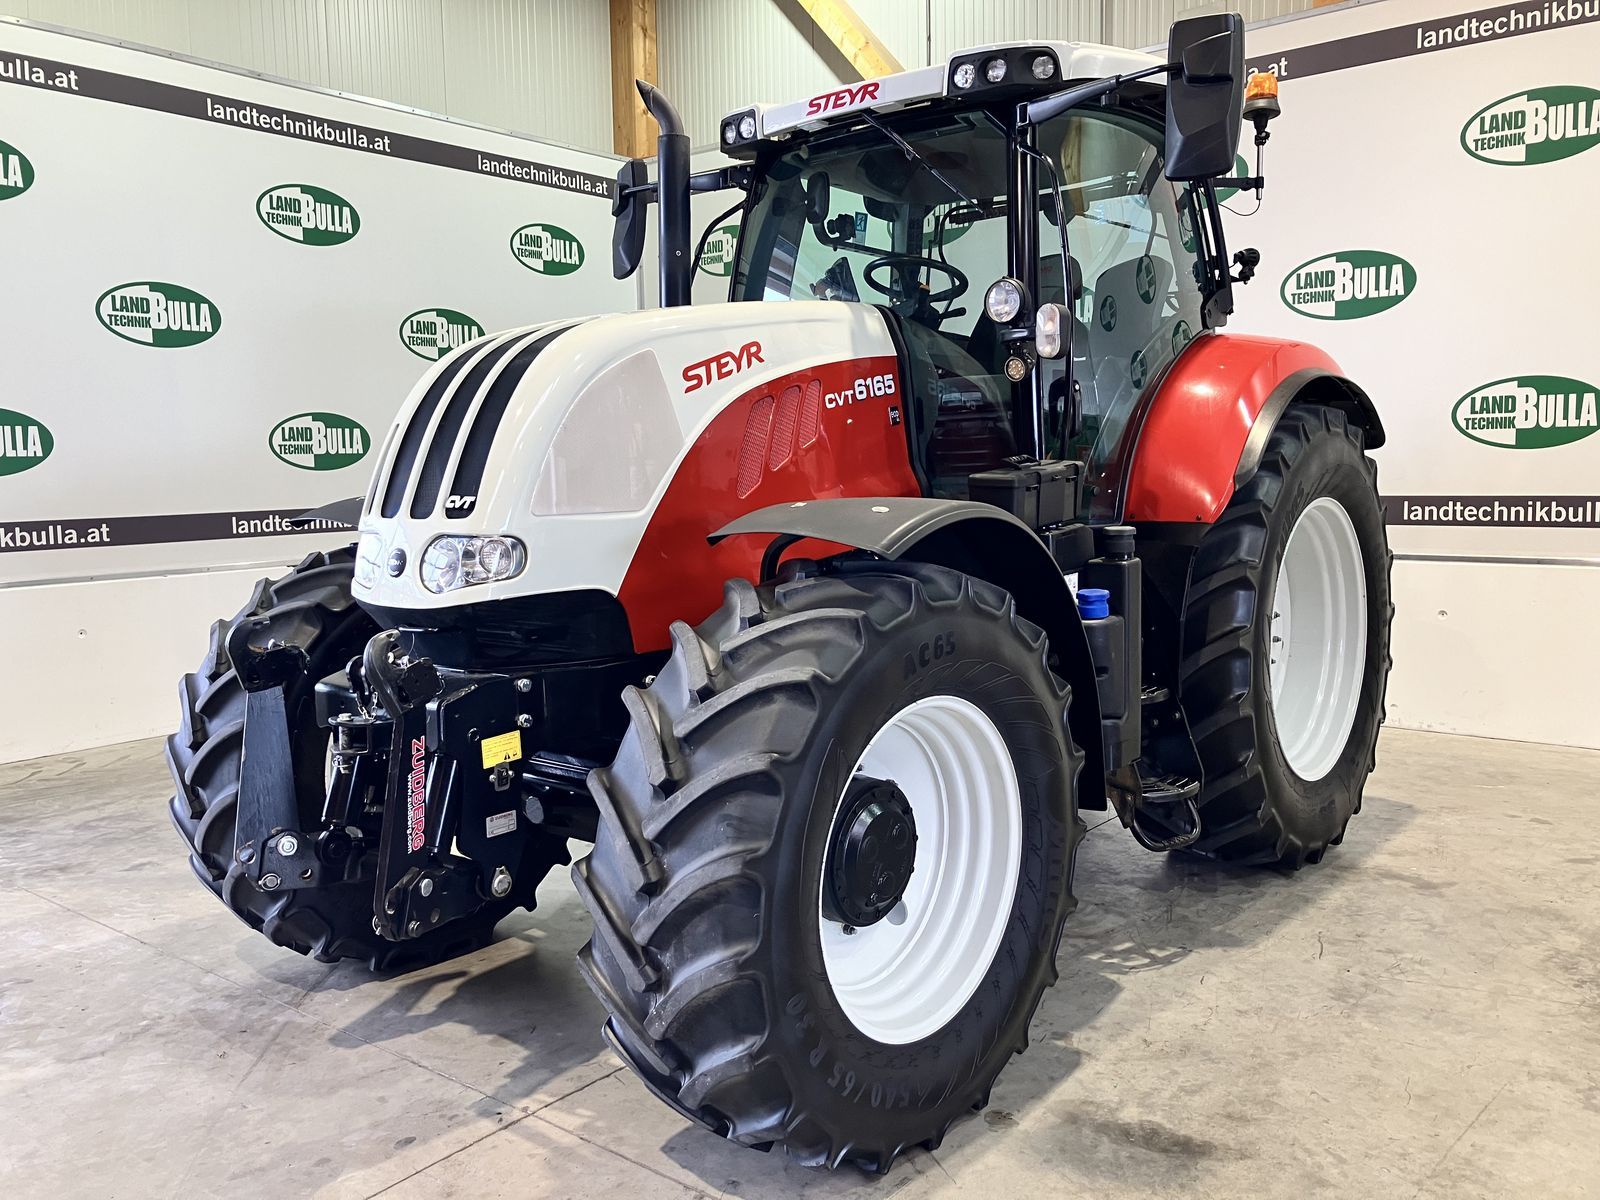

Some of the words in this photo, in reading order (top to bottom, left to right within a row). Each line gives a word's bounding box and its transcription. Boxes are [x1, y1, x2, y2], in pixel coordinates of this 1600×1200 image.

[1417, 0, 1599, 49] landtechnikbu
[806, 82, 880, 117] STEYR
[206, 97, 391, 153] landtechnikbulla.at
[1479, 109, 1526, 135] LAND
[1473, 131, 1526, 152] TECHNIK
[477, 154, 608, 196] landtechnikbulla.at
[266, 212, 302, 228] TECHNIK
[269, 194, 301, 214] LAND
[301, 193, 353, 234] BULLA
[516, 247, 543, 260] TECHNIK
[519, 232, 542, 249] LAND
[543, 231, 580, 266] BULLA
[700, 255, 724, 266] TECHNIK
[1296, 269, 1335, 291] LAND
[1337, 262, 1405, 300] BULLA
[111, 294, 150, 314] LAND
[151, 291, 212, 332] BULLA
[1291, 289, 1335, 305] TECHNIK
[107, 314, 152, 329] TECHNIK
[410, 319, 437, 336] LAND
[407, 335, 438, 348] TECHNIK
[682, 340, 765, 394] STEYR
[824, 389, 855, 409] CVT
[854, 373, 896, 401] 6165
[1470, 394, 1516, 415] LAND
[1517, 387, 1598, 429] BULLA
[281, 426, 313, 442] LAND
[313, 421, 363, 454] BULLA
[1464, 416, 1516, 430] TECHNIK
[278, 443, 314, 455] TECHNIK
[445, 495, 476, 509] CVT
[0, 523, 110, 547] kbulla.at
[411, 735, 425, 850] ZUIDBERG
